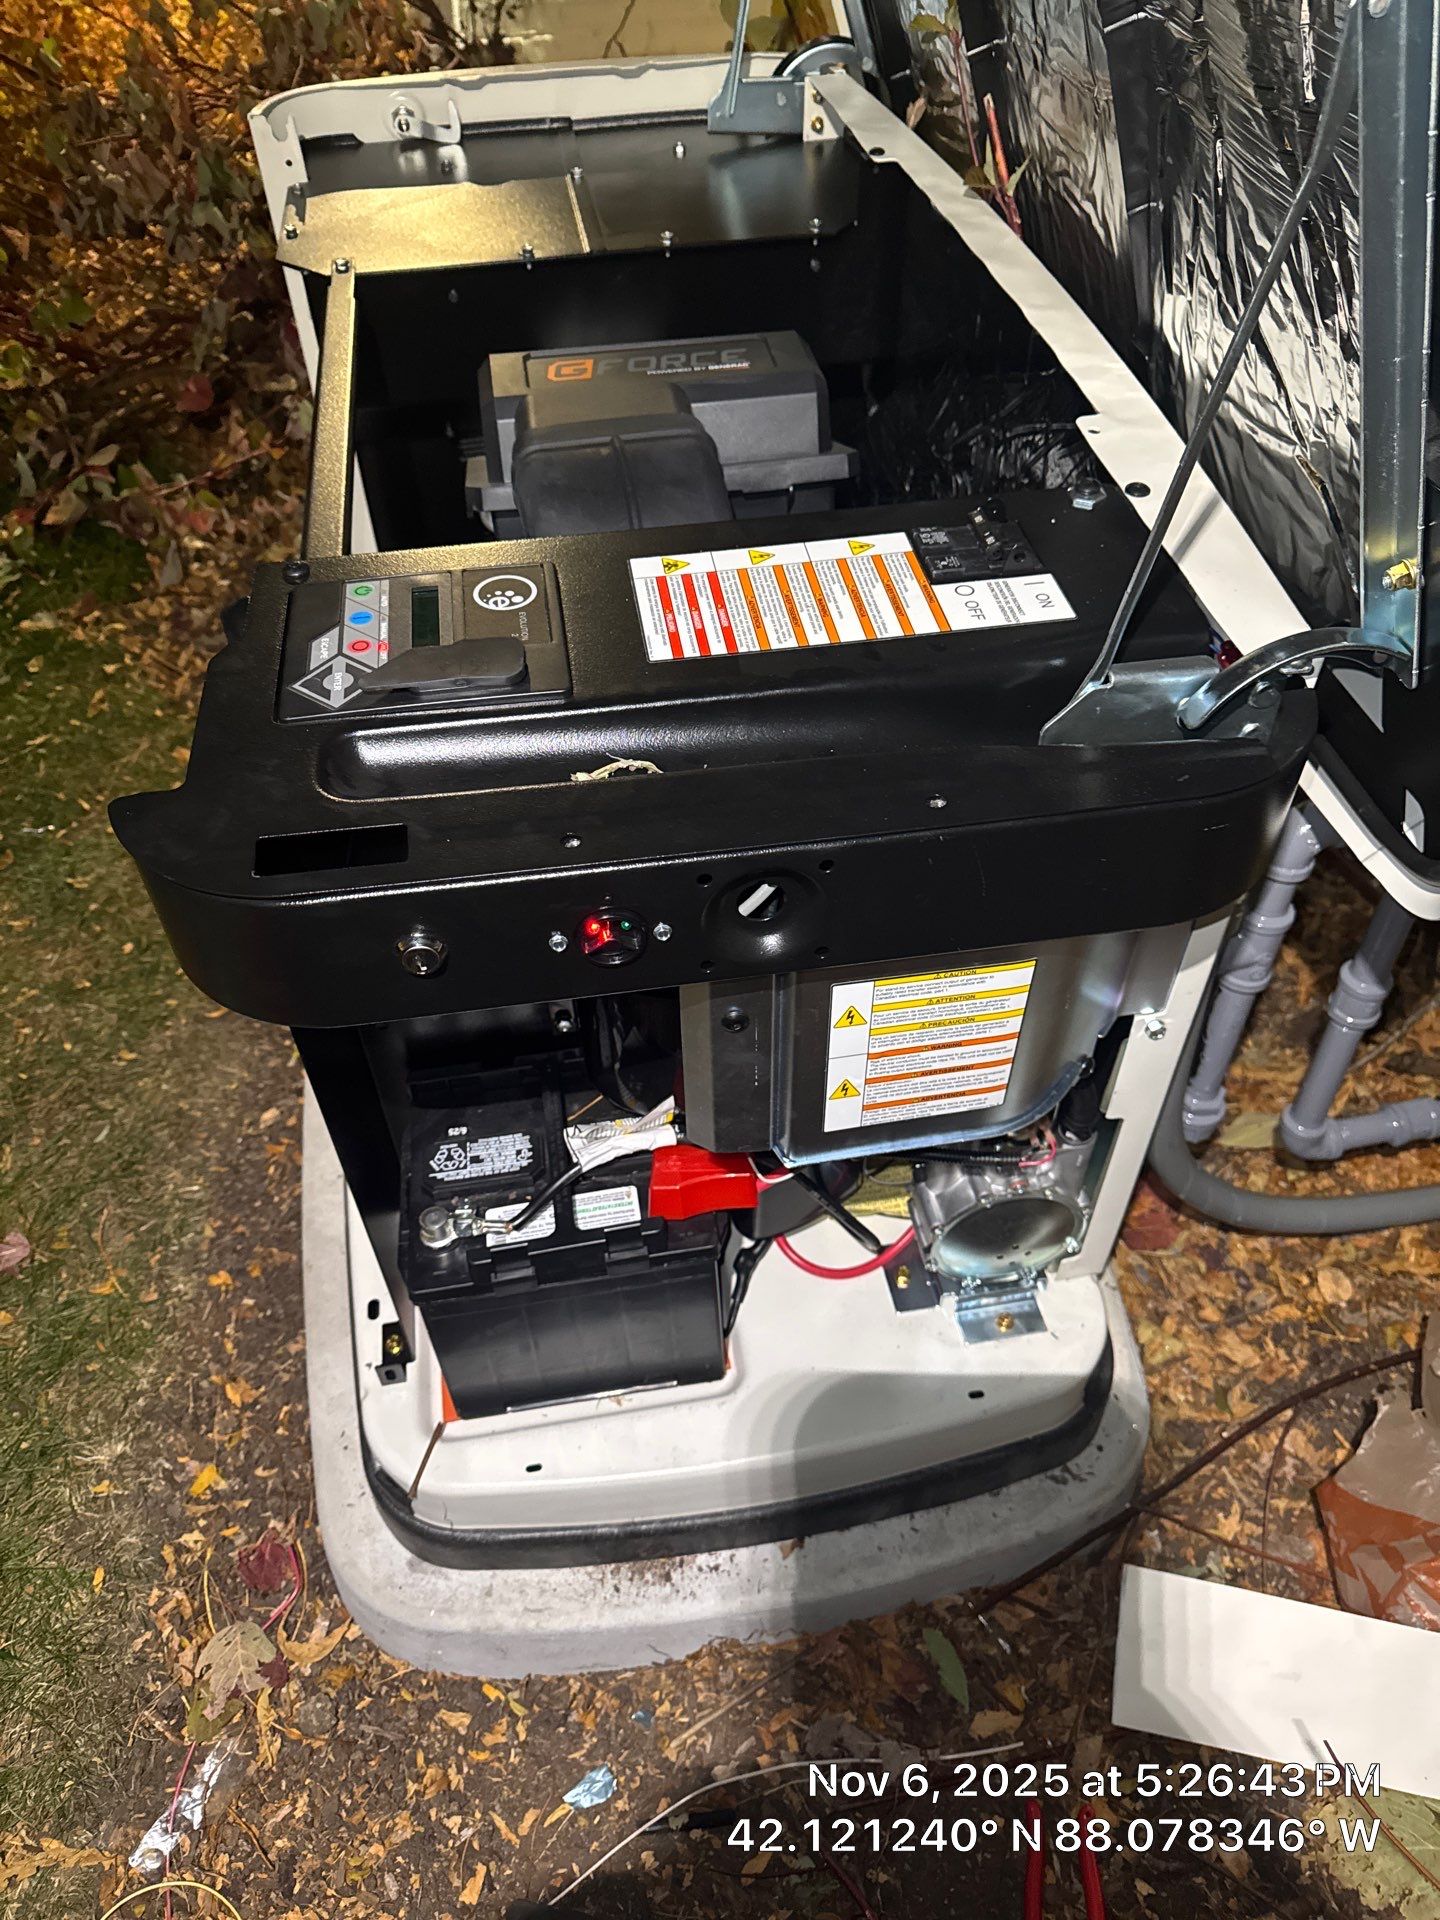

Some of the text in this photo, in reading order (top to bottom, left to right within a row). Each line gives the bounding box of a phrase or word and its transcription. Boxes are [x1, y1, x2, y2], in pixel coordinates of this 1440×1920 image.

[923, 583, 936, 604] WARNING
[1035, 593, 1055, 608] ON
[818, 595, 829, 618] WARNING
[965, 600, 986, 620] OFF
[518, 611, 529, 641] EVOLUTION
[691, 611, 703, 629] DANGER
[717, 608, 729, 627] DANGER
[320, 638, 330, 660] ESCAPE
[333, 672, 343, 692] ENTER
[943, 969, 976, 978] CAUTION
[935, 993, 975, 1003] ATTENTION
[928, 1015, 975, 1027] PRECAUCIÓN
[930, 1041, 962, 1050] WARNING
[921, 1064, 974, 1076] AVERTISSEMENT
[921, 1091, 966, 1101] ADVERTENCIA
